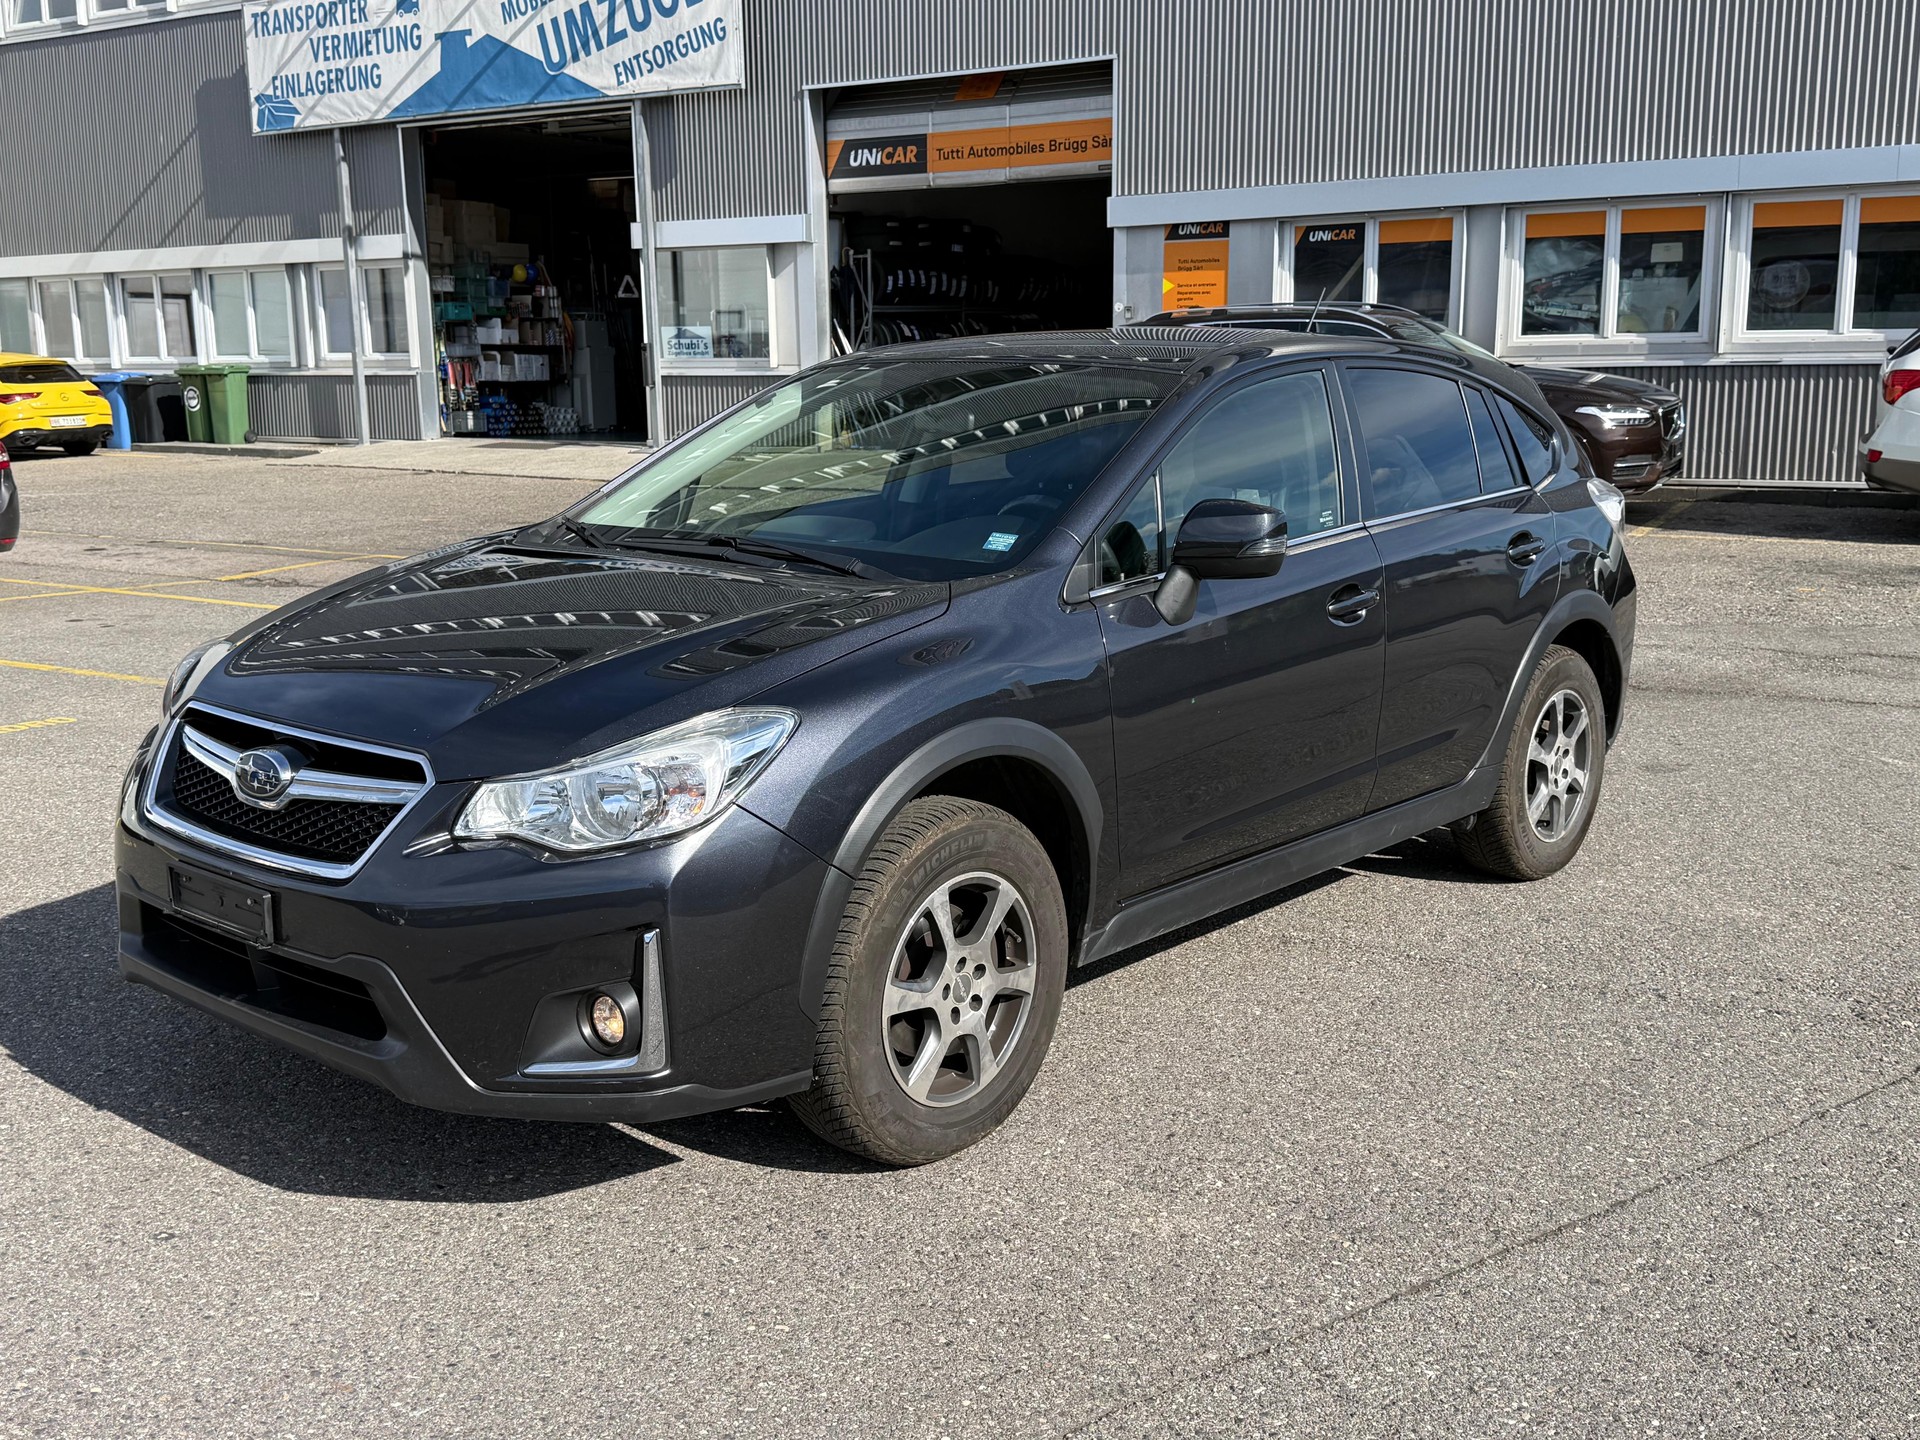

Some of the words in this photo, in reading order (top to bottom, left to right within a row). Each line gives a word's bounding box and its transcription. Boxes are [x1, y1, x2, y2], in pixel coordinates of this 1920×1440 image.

[251, 0, 368, 38] TRANSPORTER
[309, 23, 422, 63] VERMIETUNG
[613, 17, 727, 87] ENTSORGUNG
[272, 63, 382, 99] EINLAGERUNG
[936, 148, 964, 161] Tutti
[967, 141, 1045, 159] Automobiles
[1049, 137, 1088, 154] Brügg
[667, 340, 708, 350] Schubi's
[912, 834, 986, 887] MICHELIN
